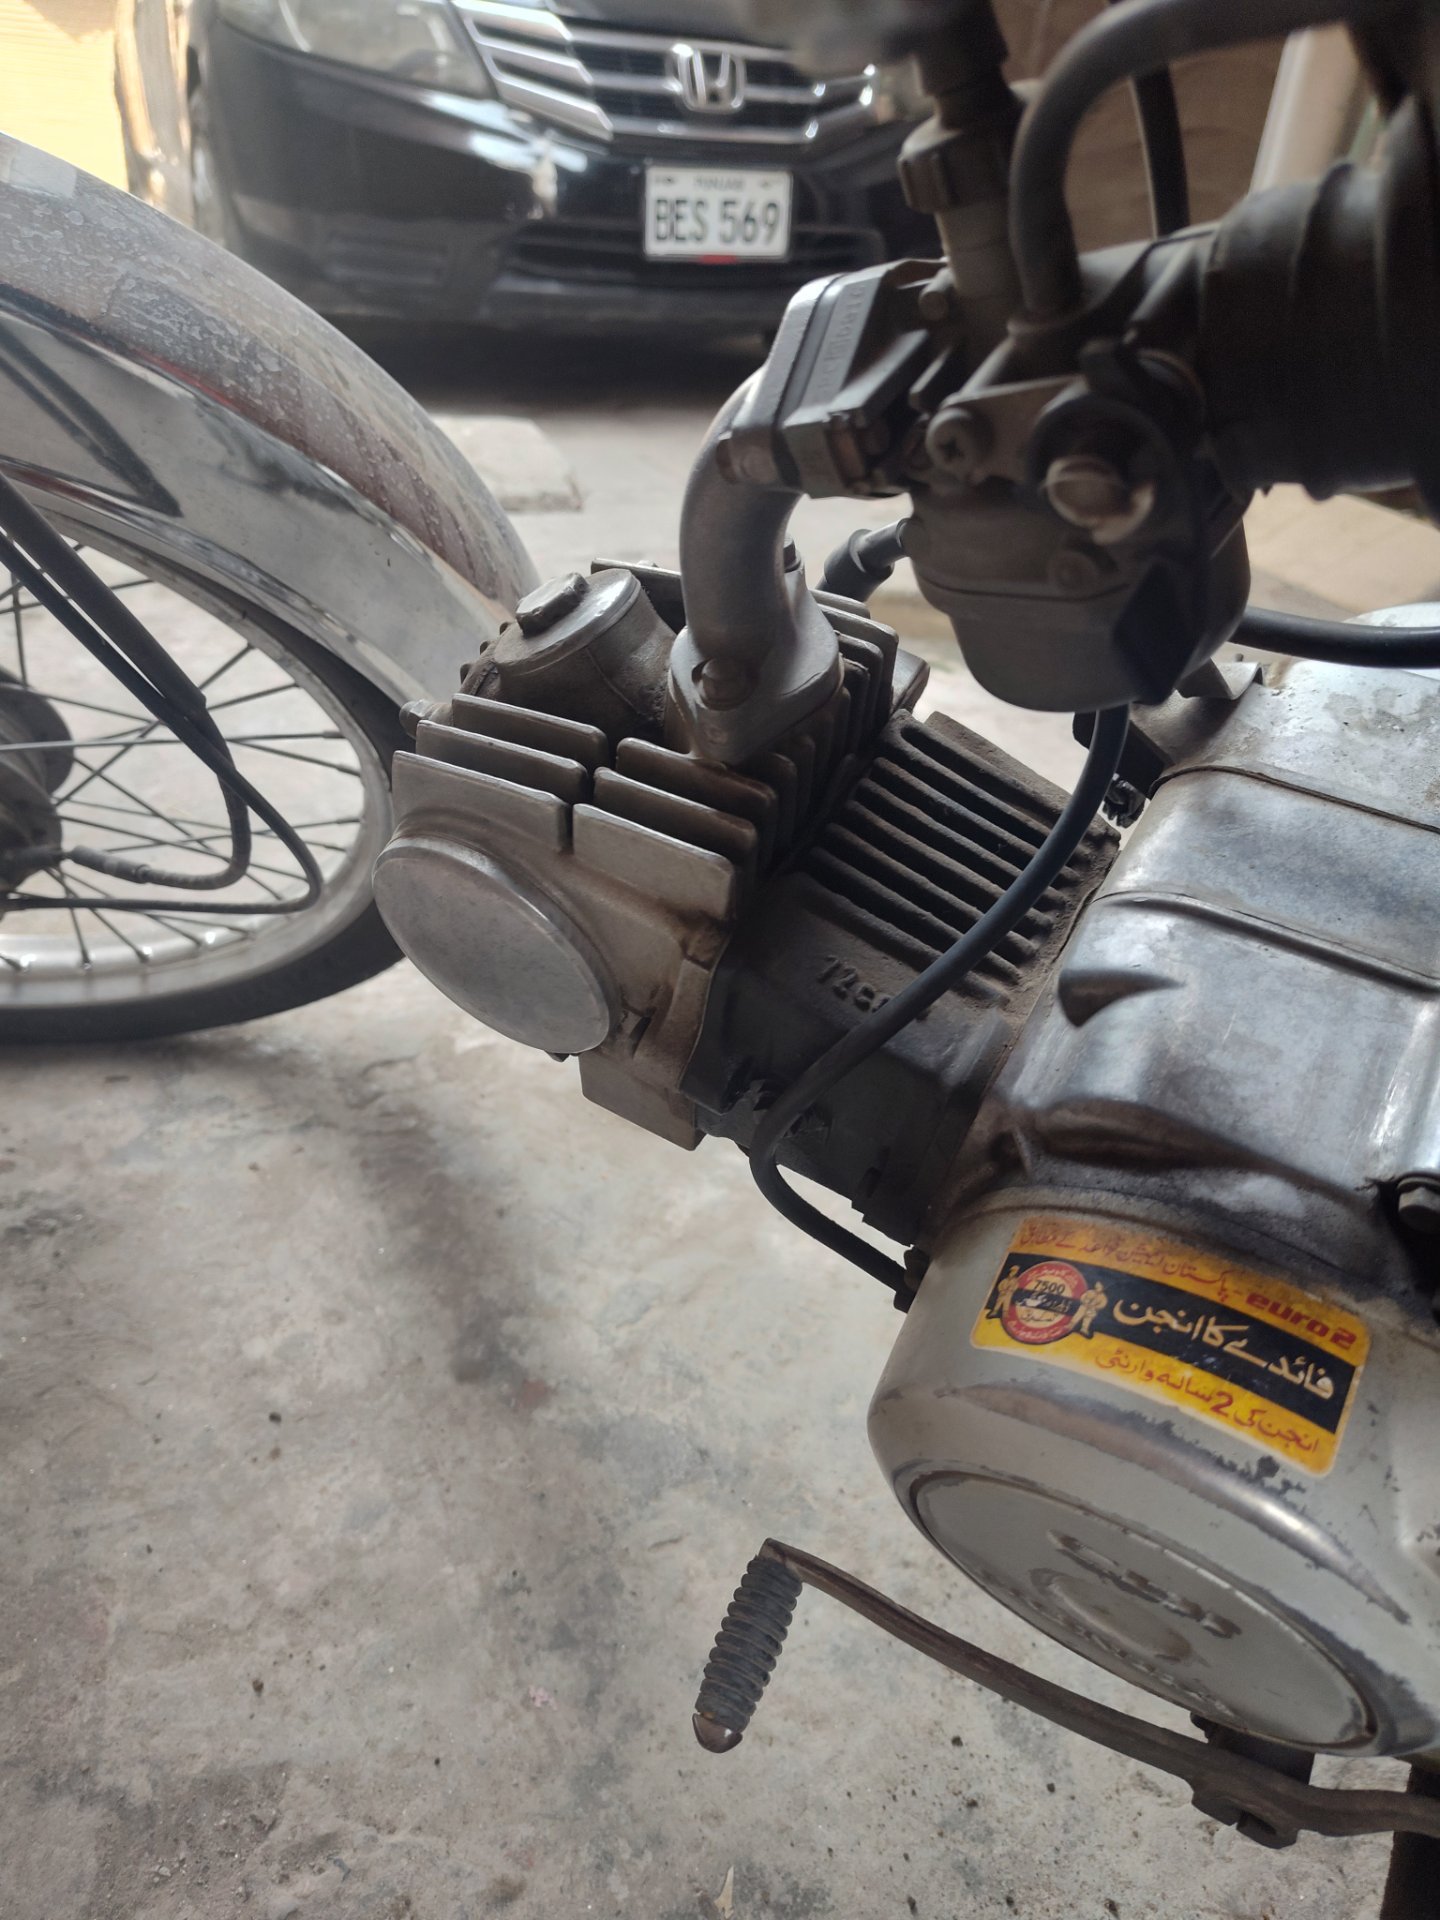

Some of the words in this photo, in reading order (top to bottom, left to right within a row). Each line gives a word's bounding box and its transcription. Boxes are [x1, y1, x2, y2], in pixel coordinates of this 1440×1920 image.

[656, 198, 709, 242] BES
[720, 200, 780, 245] 569
[1033, 1279, 1066, 1295] 7500
[1162, 1262, 1246, 1303] پاکستان
[1112, 1299, 1206, 1341] انجن
[1246, 1291, 1330, 1338] euro
[1202, 1315, 1249, 1348] کا
[1329, 1327, 1357, 1350] 2
[1095, 1347, 1155, 1382] وارنٹی
[1223, 1338, 1335, 1400] فائدے
[1156, 1371, 1214, 1402] سالہ
[1210, 1390, 1234, 1418] 2
[1232, 1408, 1268, 1429] کی
[1257, 1420, 1320, 1453] انجن
